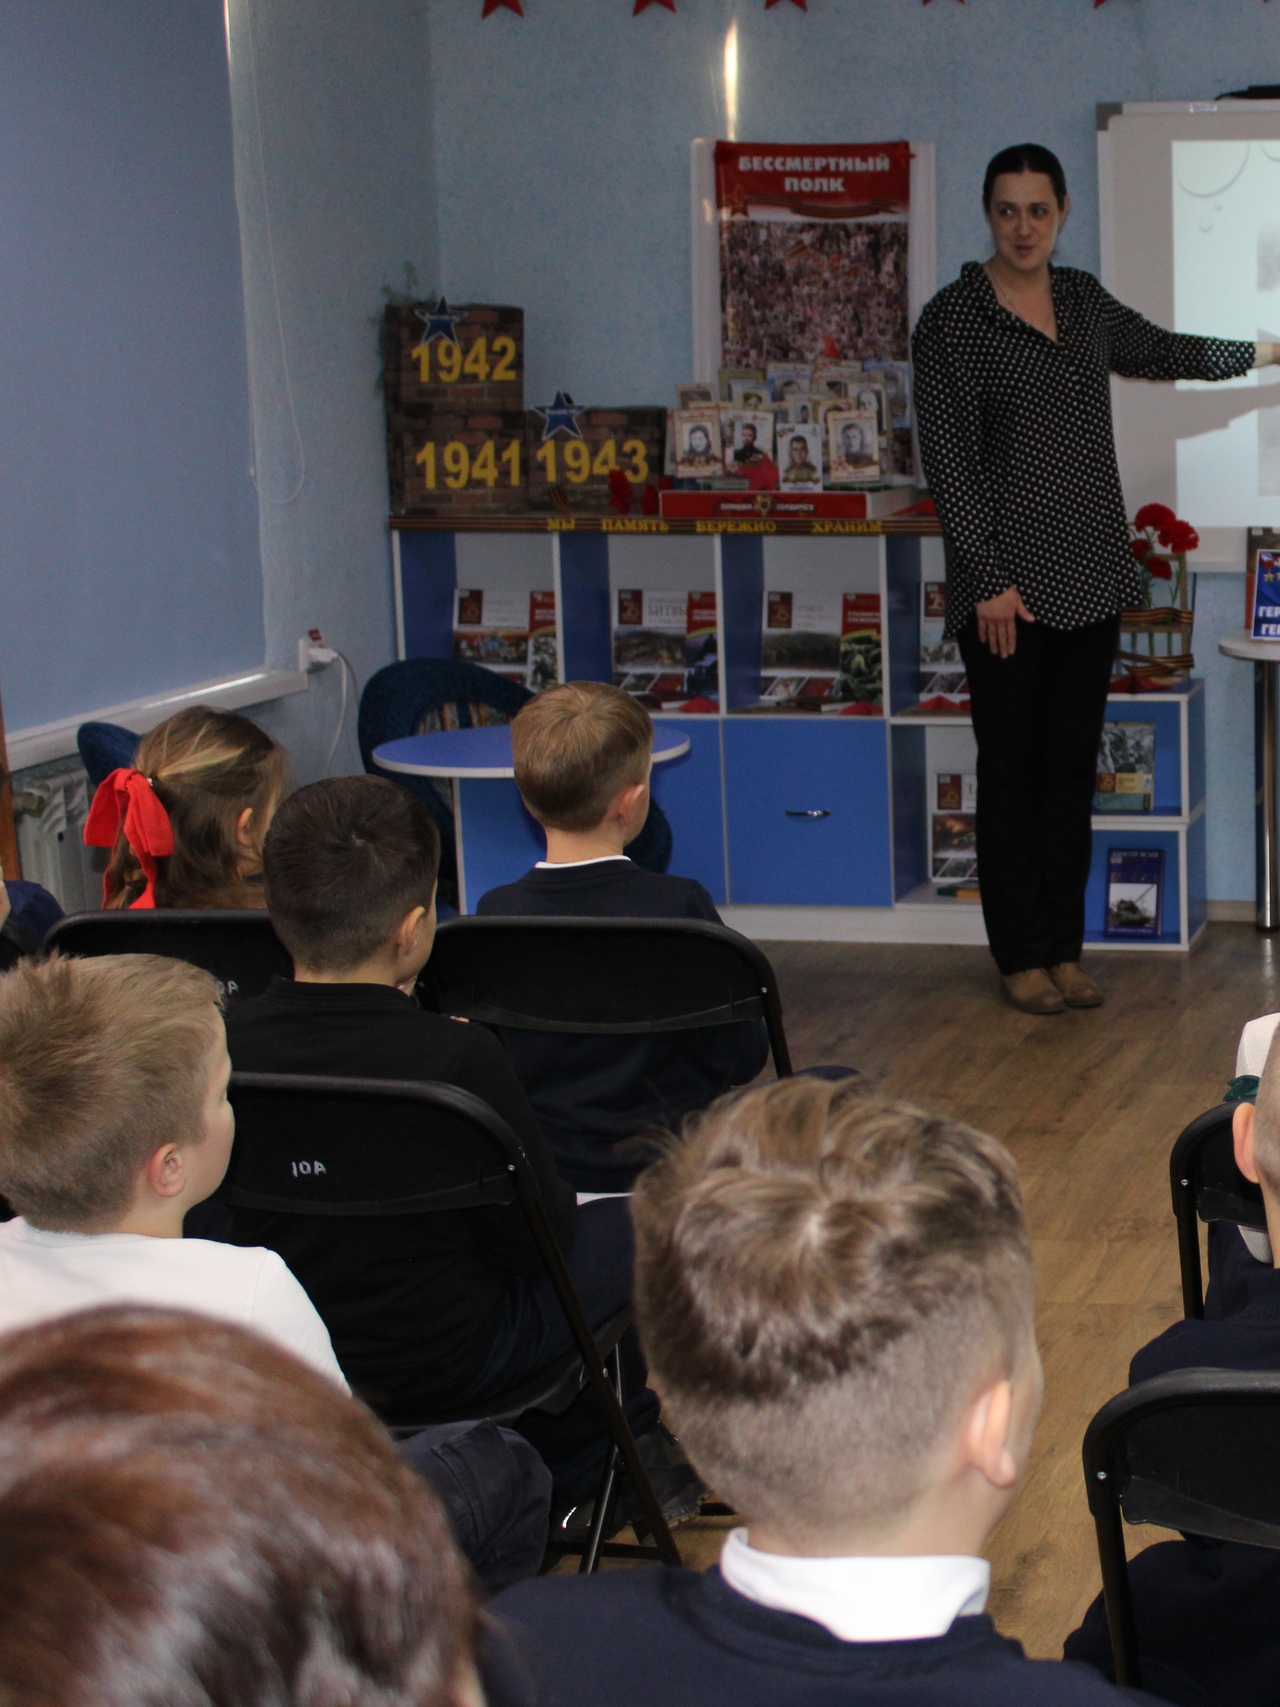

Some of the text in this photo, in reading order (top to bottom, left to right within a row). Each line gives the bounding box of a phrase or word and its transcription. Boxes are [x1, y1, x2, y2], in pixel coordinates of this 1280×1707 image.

[738, 153, 891, 171] БЕССМЕРТНЫЙ
[784, 177, 846, 192] ПОЛК
[411, 336, 517, 383] 1942
[416, 439, 521, 489] 1941
[536, 439, 649, 484] 1943
[547, 518, 883, 533] МЫ ПАМЯТЬ БЕРЕЖНО ХРАНИМ
